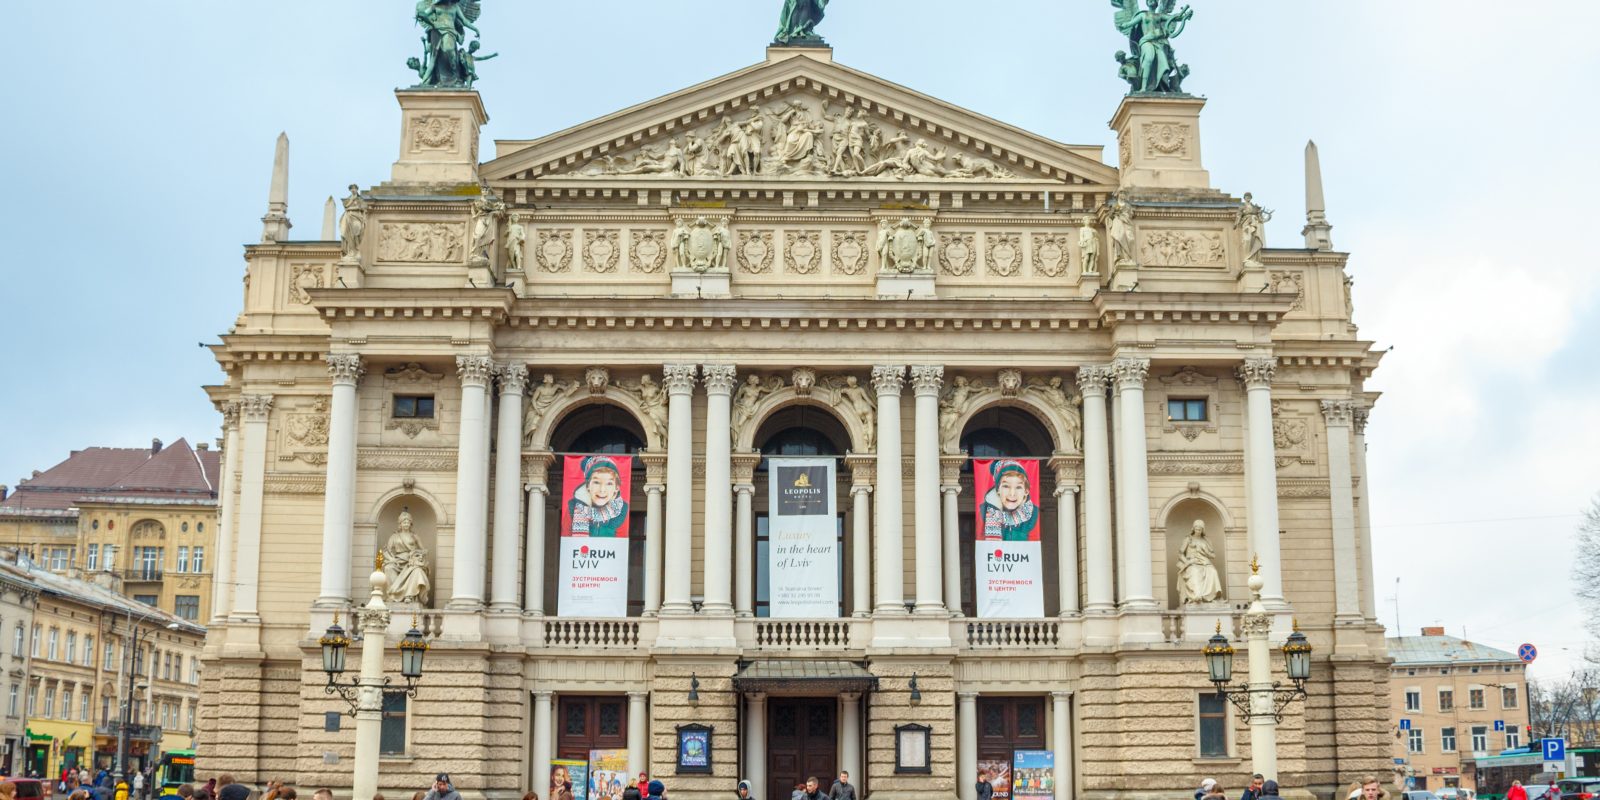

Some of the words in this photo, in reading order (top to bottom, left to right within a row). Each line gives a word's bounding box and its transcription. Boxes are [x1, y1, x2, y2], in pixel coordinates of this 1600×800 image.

[778, 530, 811, 541] Luxury
[776, 545, 786, 554] in
[789, 544, 804, 554] the
[806, 544, 832, 554] heart
[572, 560, 599, 569] LVIV
[776, 558, 788, 570] of
[790, 558, 813, 568] Lviv
[987, 563, 1014, 573] LVIV
[1547, 741, 1559, 758] P
